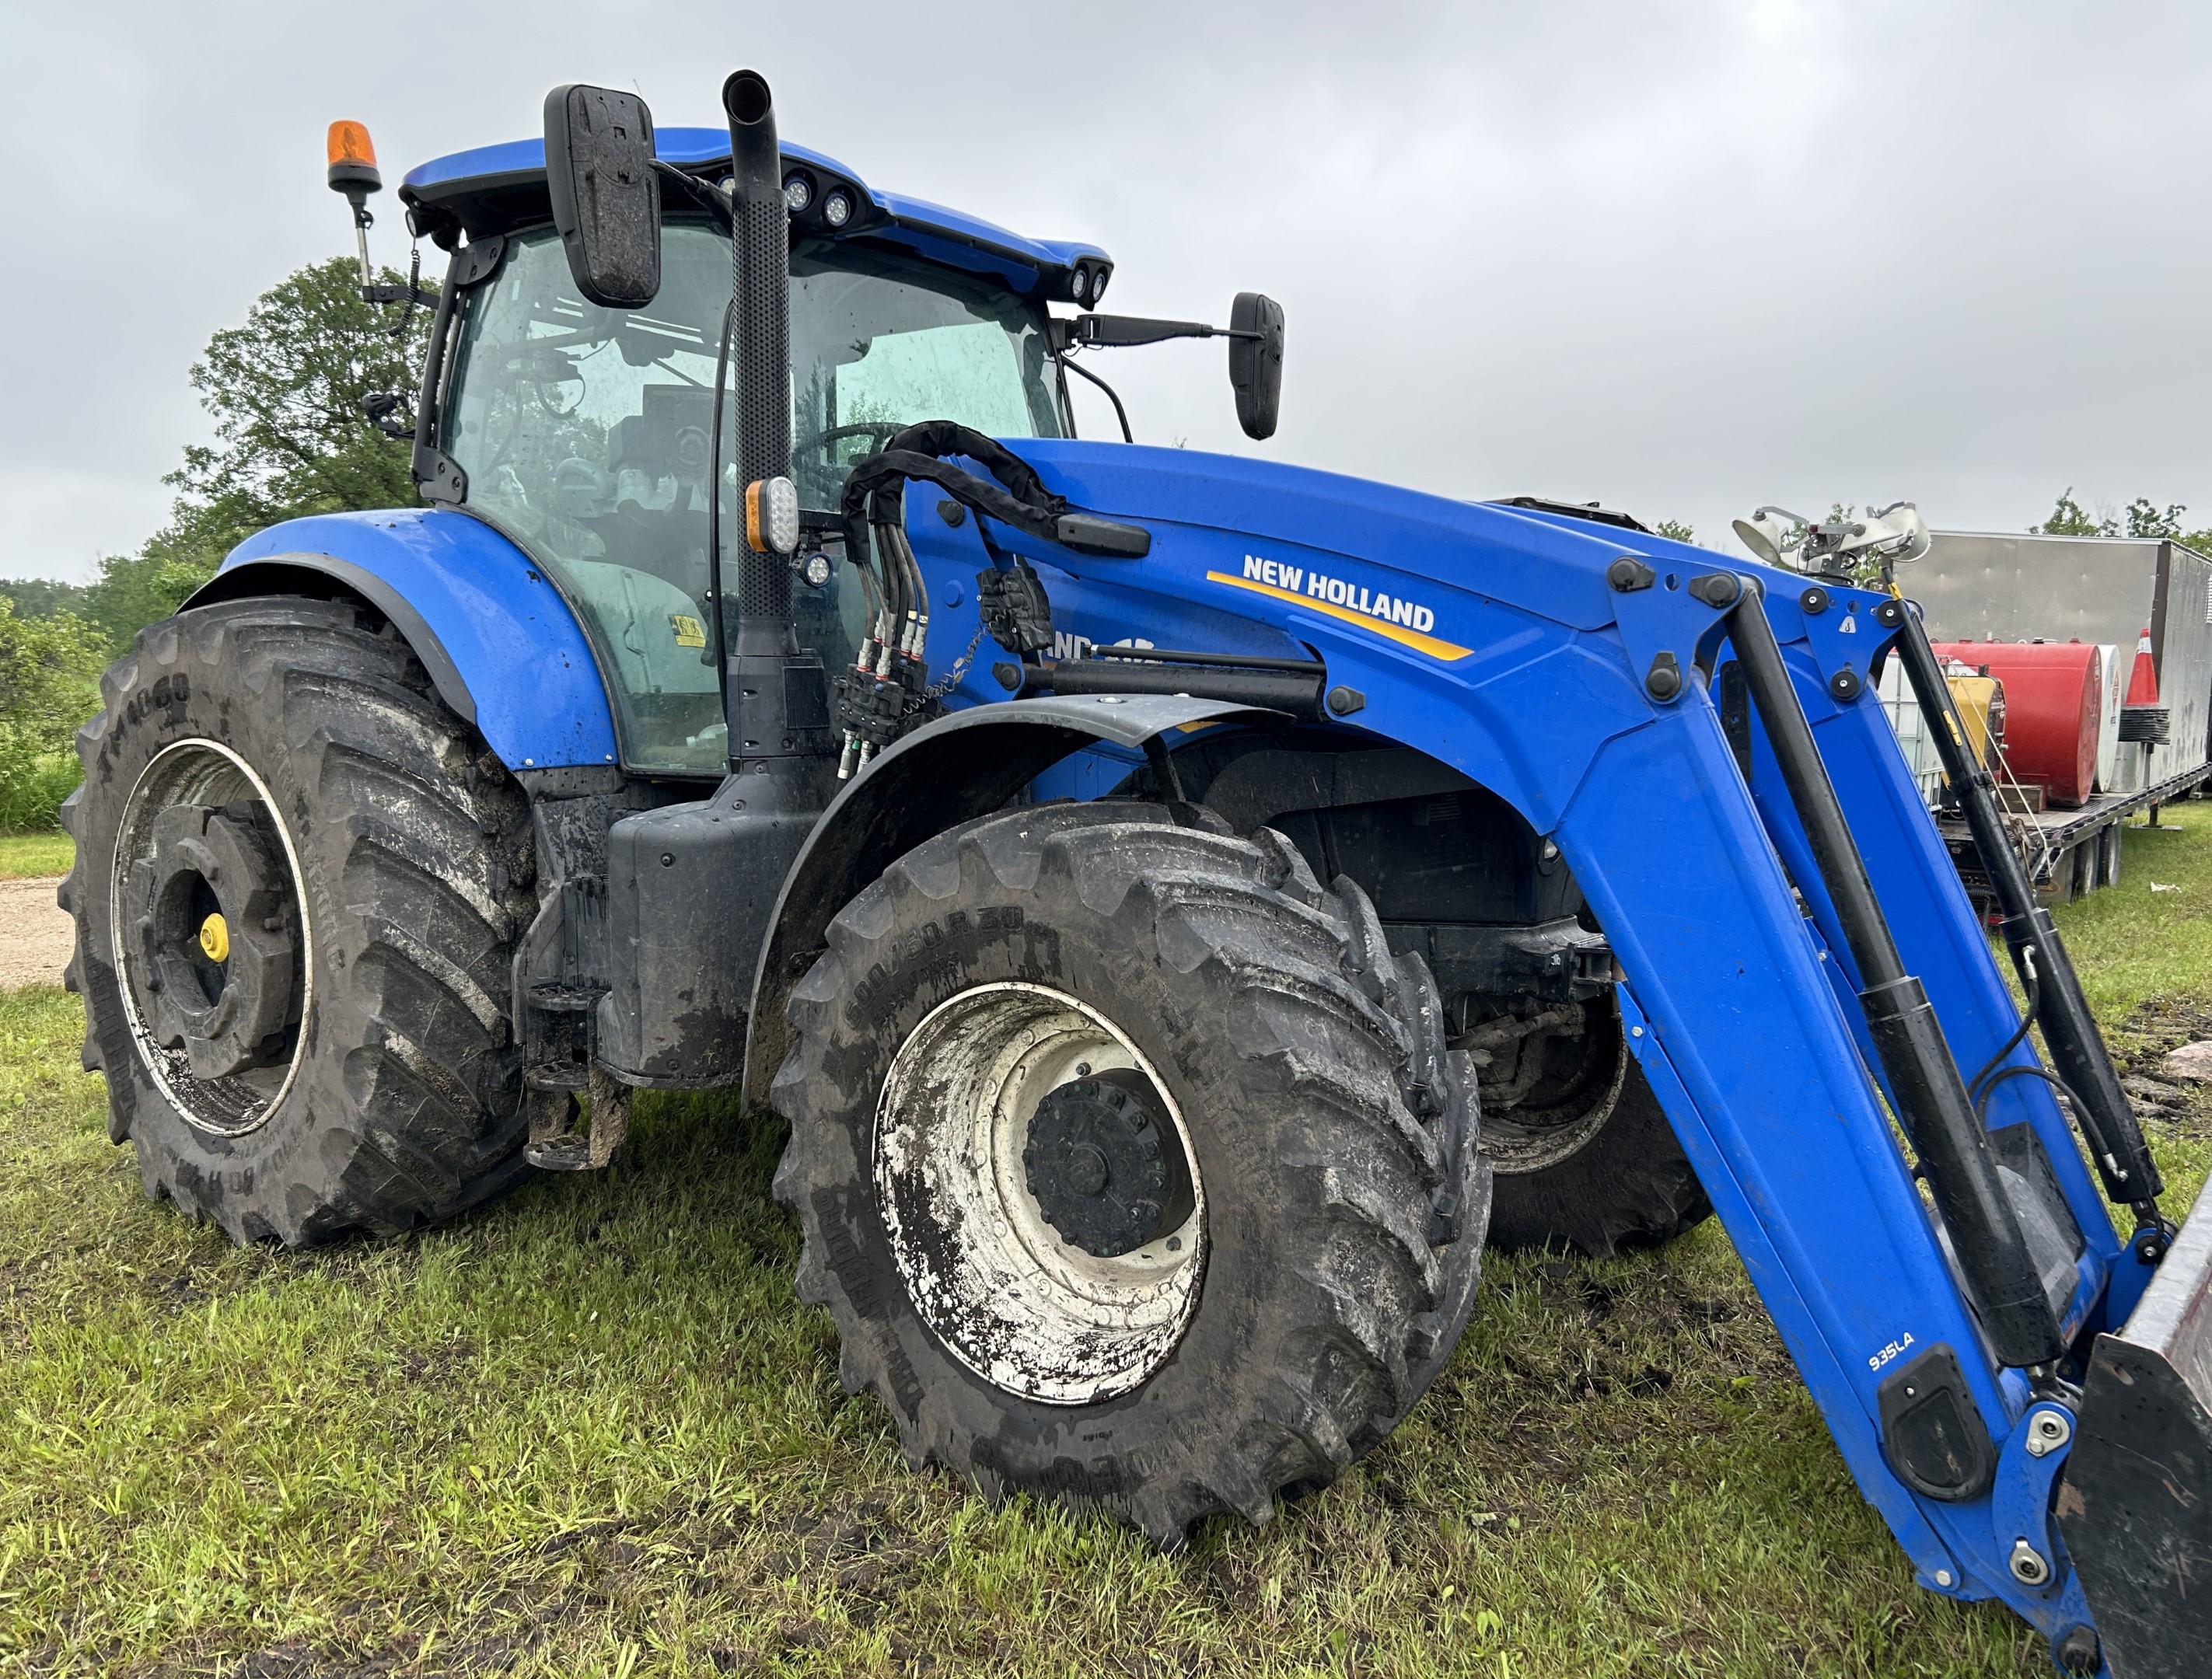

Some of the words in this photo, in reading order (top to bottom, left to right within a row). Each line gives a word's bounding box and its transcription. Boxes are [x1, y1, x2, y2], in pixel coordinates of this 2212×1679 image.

[1243, 554, 1302, 592] NEW
[1308, 572, 1434, 633] HOLLAND
[1868, 1332, 1915, 1372] 935LA
